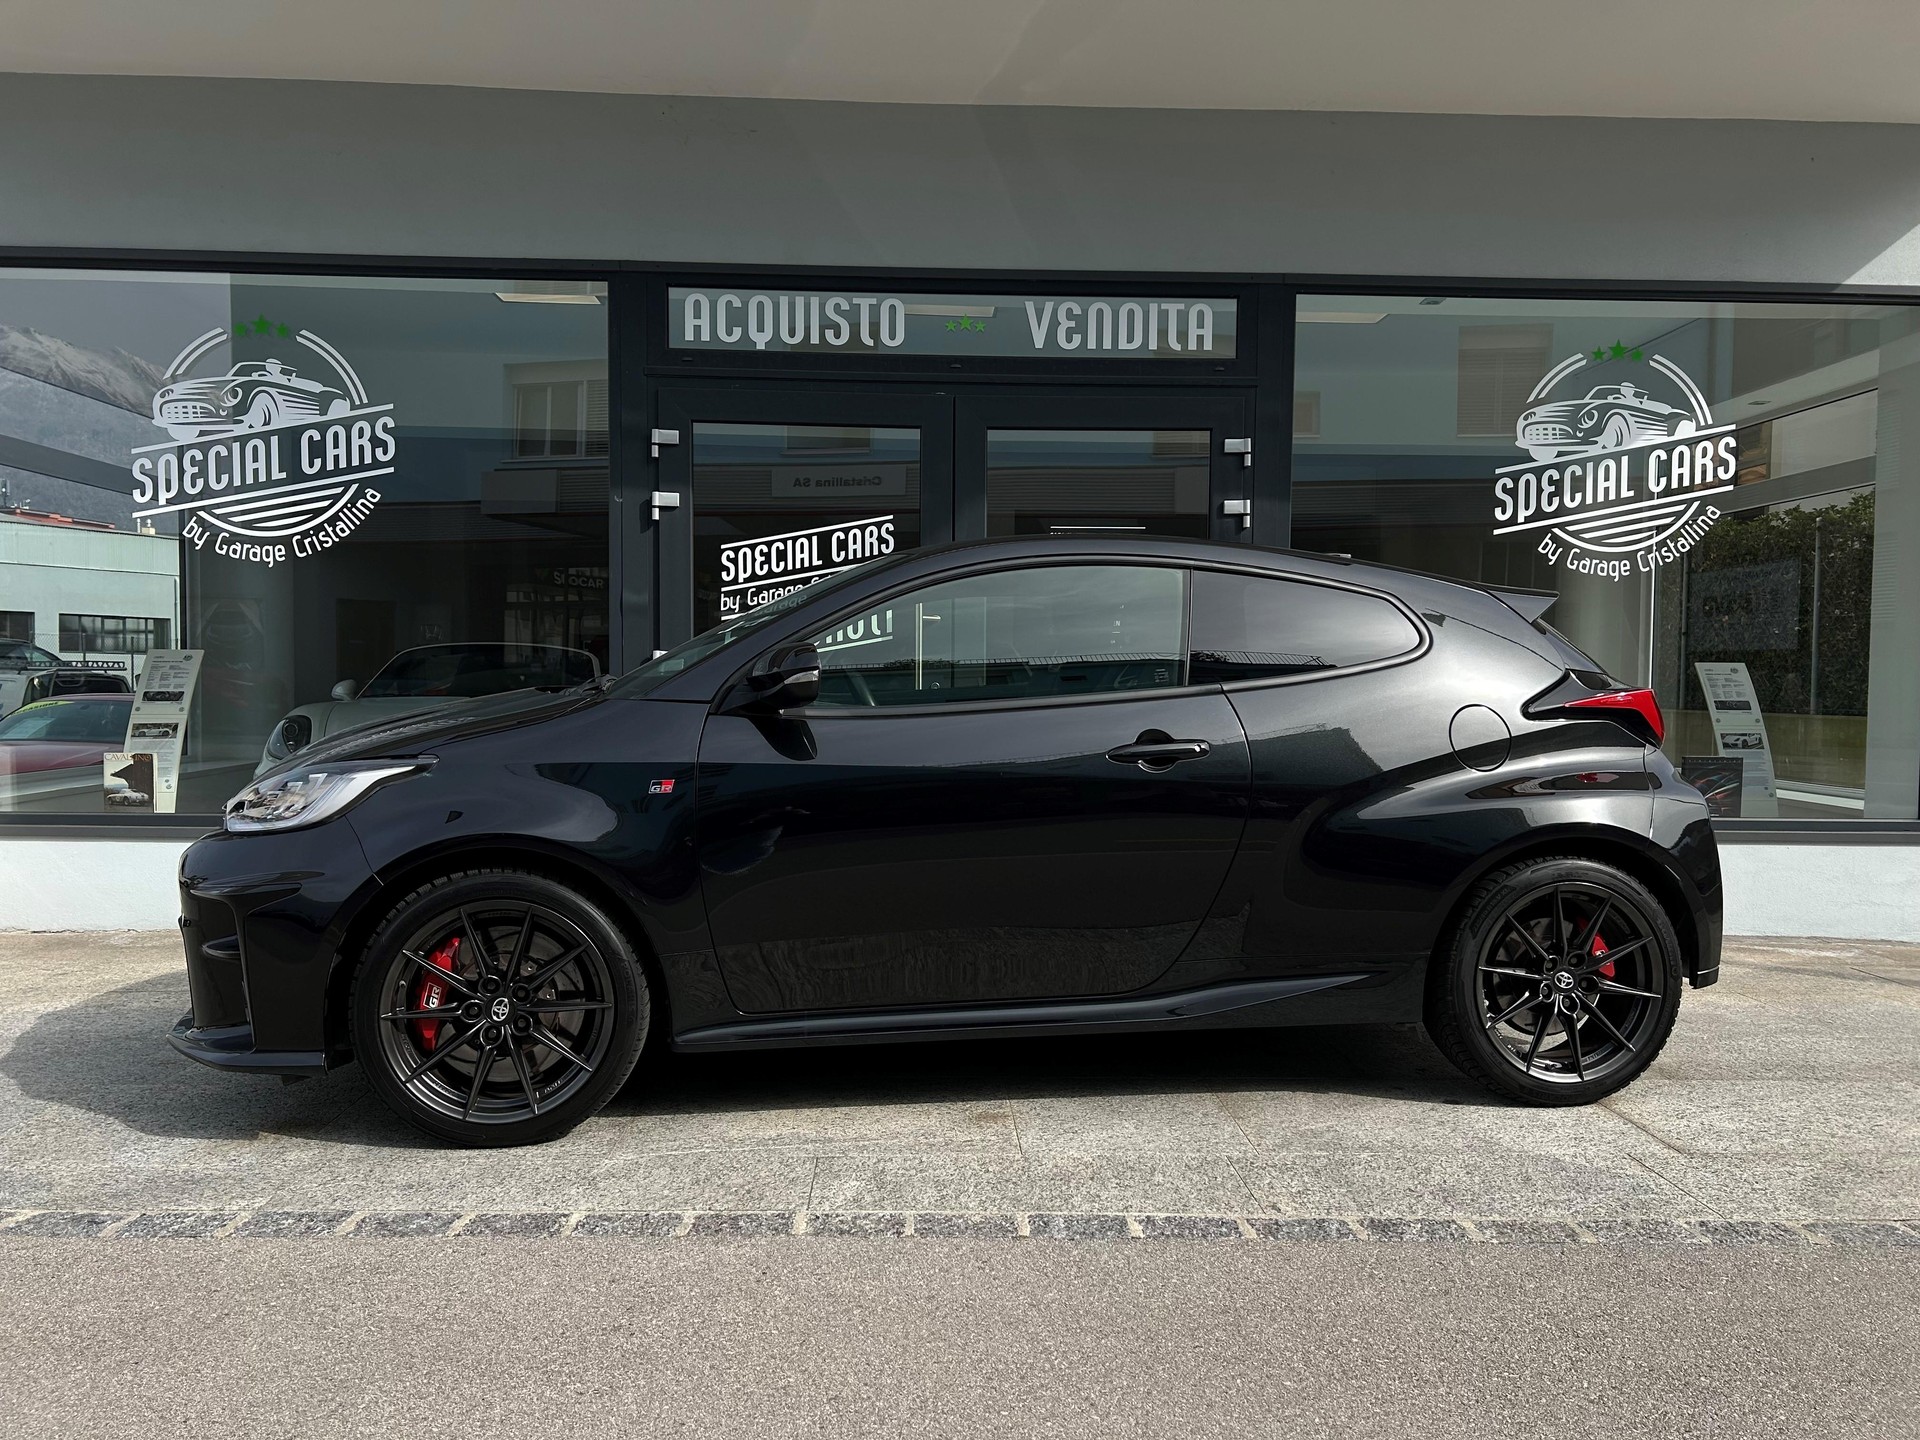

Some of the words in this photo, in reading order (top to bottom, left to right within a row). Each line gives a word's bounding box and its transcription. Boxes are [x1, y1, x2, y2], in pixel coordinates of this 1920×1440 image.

[684, 293, 905, 350] ACQUISTO
[1024, 301, 1213, 351] VENDITA
[131, 435, 287, 506] SPECIAL
[300, 416, 396, 475] CARS
[1494, 455, 1635, 523] SPECIAL
[1648, 436, 1737, 493] CARS
[181, 516, 211, 550] by
[214, 533, 286, 568] Garage
[292, 487, 382, 558] Cristallina
[720, 534, 823, 584] SPECIAL
[831, 522, 895, 563] CARS
[1537, 532, 1563, 566] by
[1566, 548, 1631, 583] Garage
[1636, 504, 1722, 573] Cristallina
[720, 593, 741, 613] by
[649, 783, 673, 793] GR
[427, 985, 441, 1008] GR
